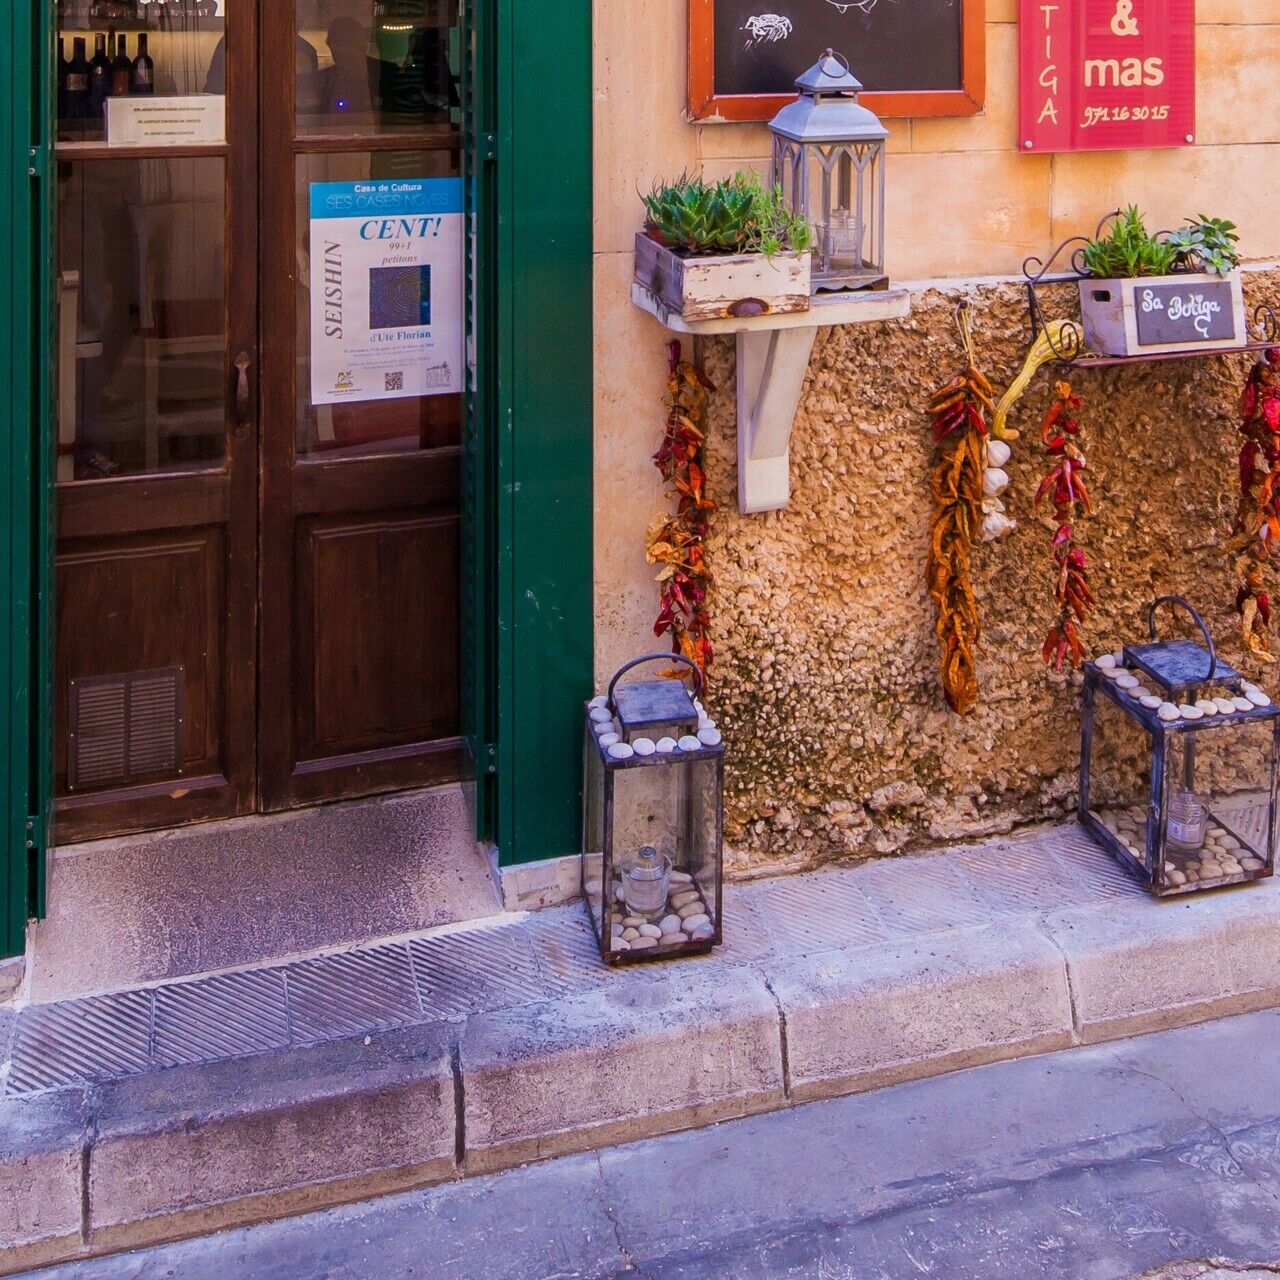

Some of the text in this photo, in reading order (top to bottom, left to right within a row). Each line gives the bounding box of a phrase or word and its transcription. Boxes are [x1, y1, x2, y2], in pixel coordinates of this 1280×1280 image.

[1083, 56, 1165, 88] mas
[1080, 105, 1171, 128] 971 16 30 15
[354, 183, 423, 194] Casa de Cultura
[359, 216, 443, 241] CENT!
[388, 241, 411, 251] 99+1
[381, 254, 419, 266] petitons
[324, 240, 343, 340] SEISHIN
[1142, 288, 1221, 339] Sa Botiga
[396, 329, 432, 341] Florian
